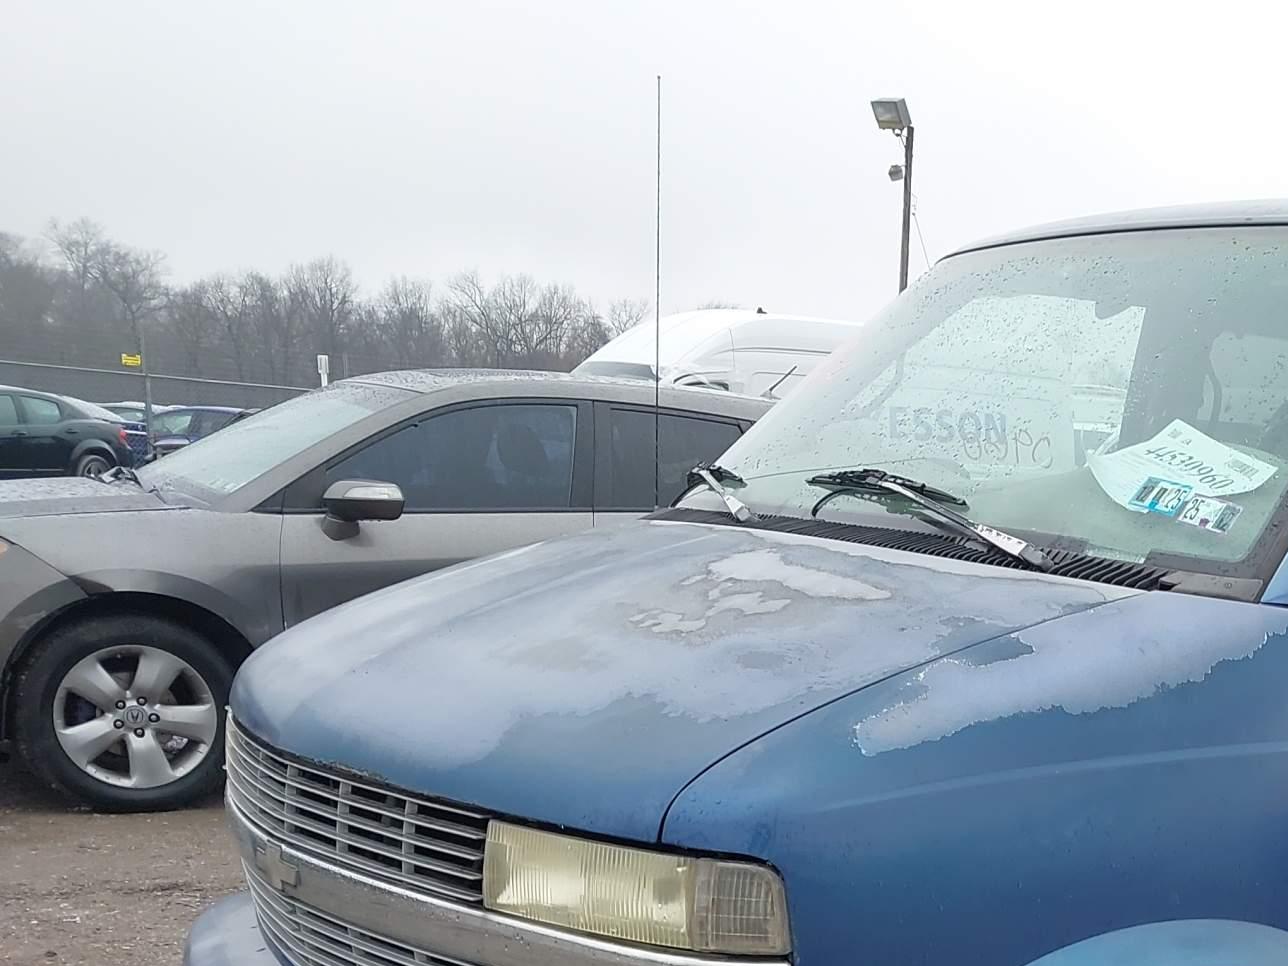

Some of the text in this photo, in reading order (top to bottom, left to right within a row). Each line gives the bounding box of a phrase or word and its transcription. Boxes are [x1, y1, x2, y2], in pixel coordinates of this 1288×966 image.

[1144, 446, 1235, 490] 44530960
[1164, 489, 1187, 510] 25
[1184, 498, 1206, 521] 25
